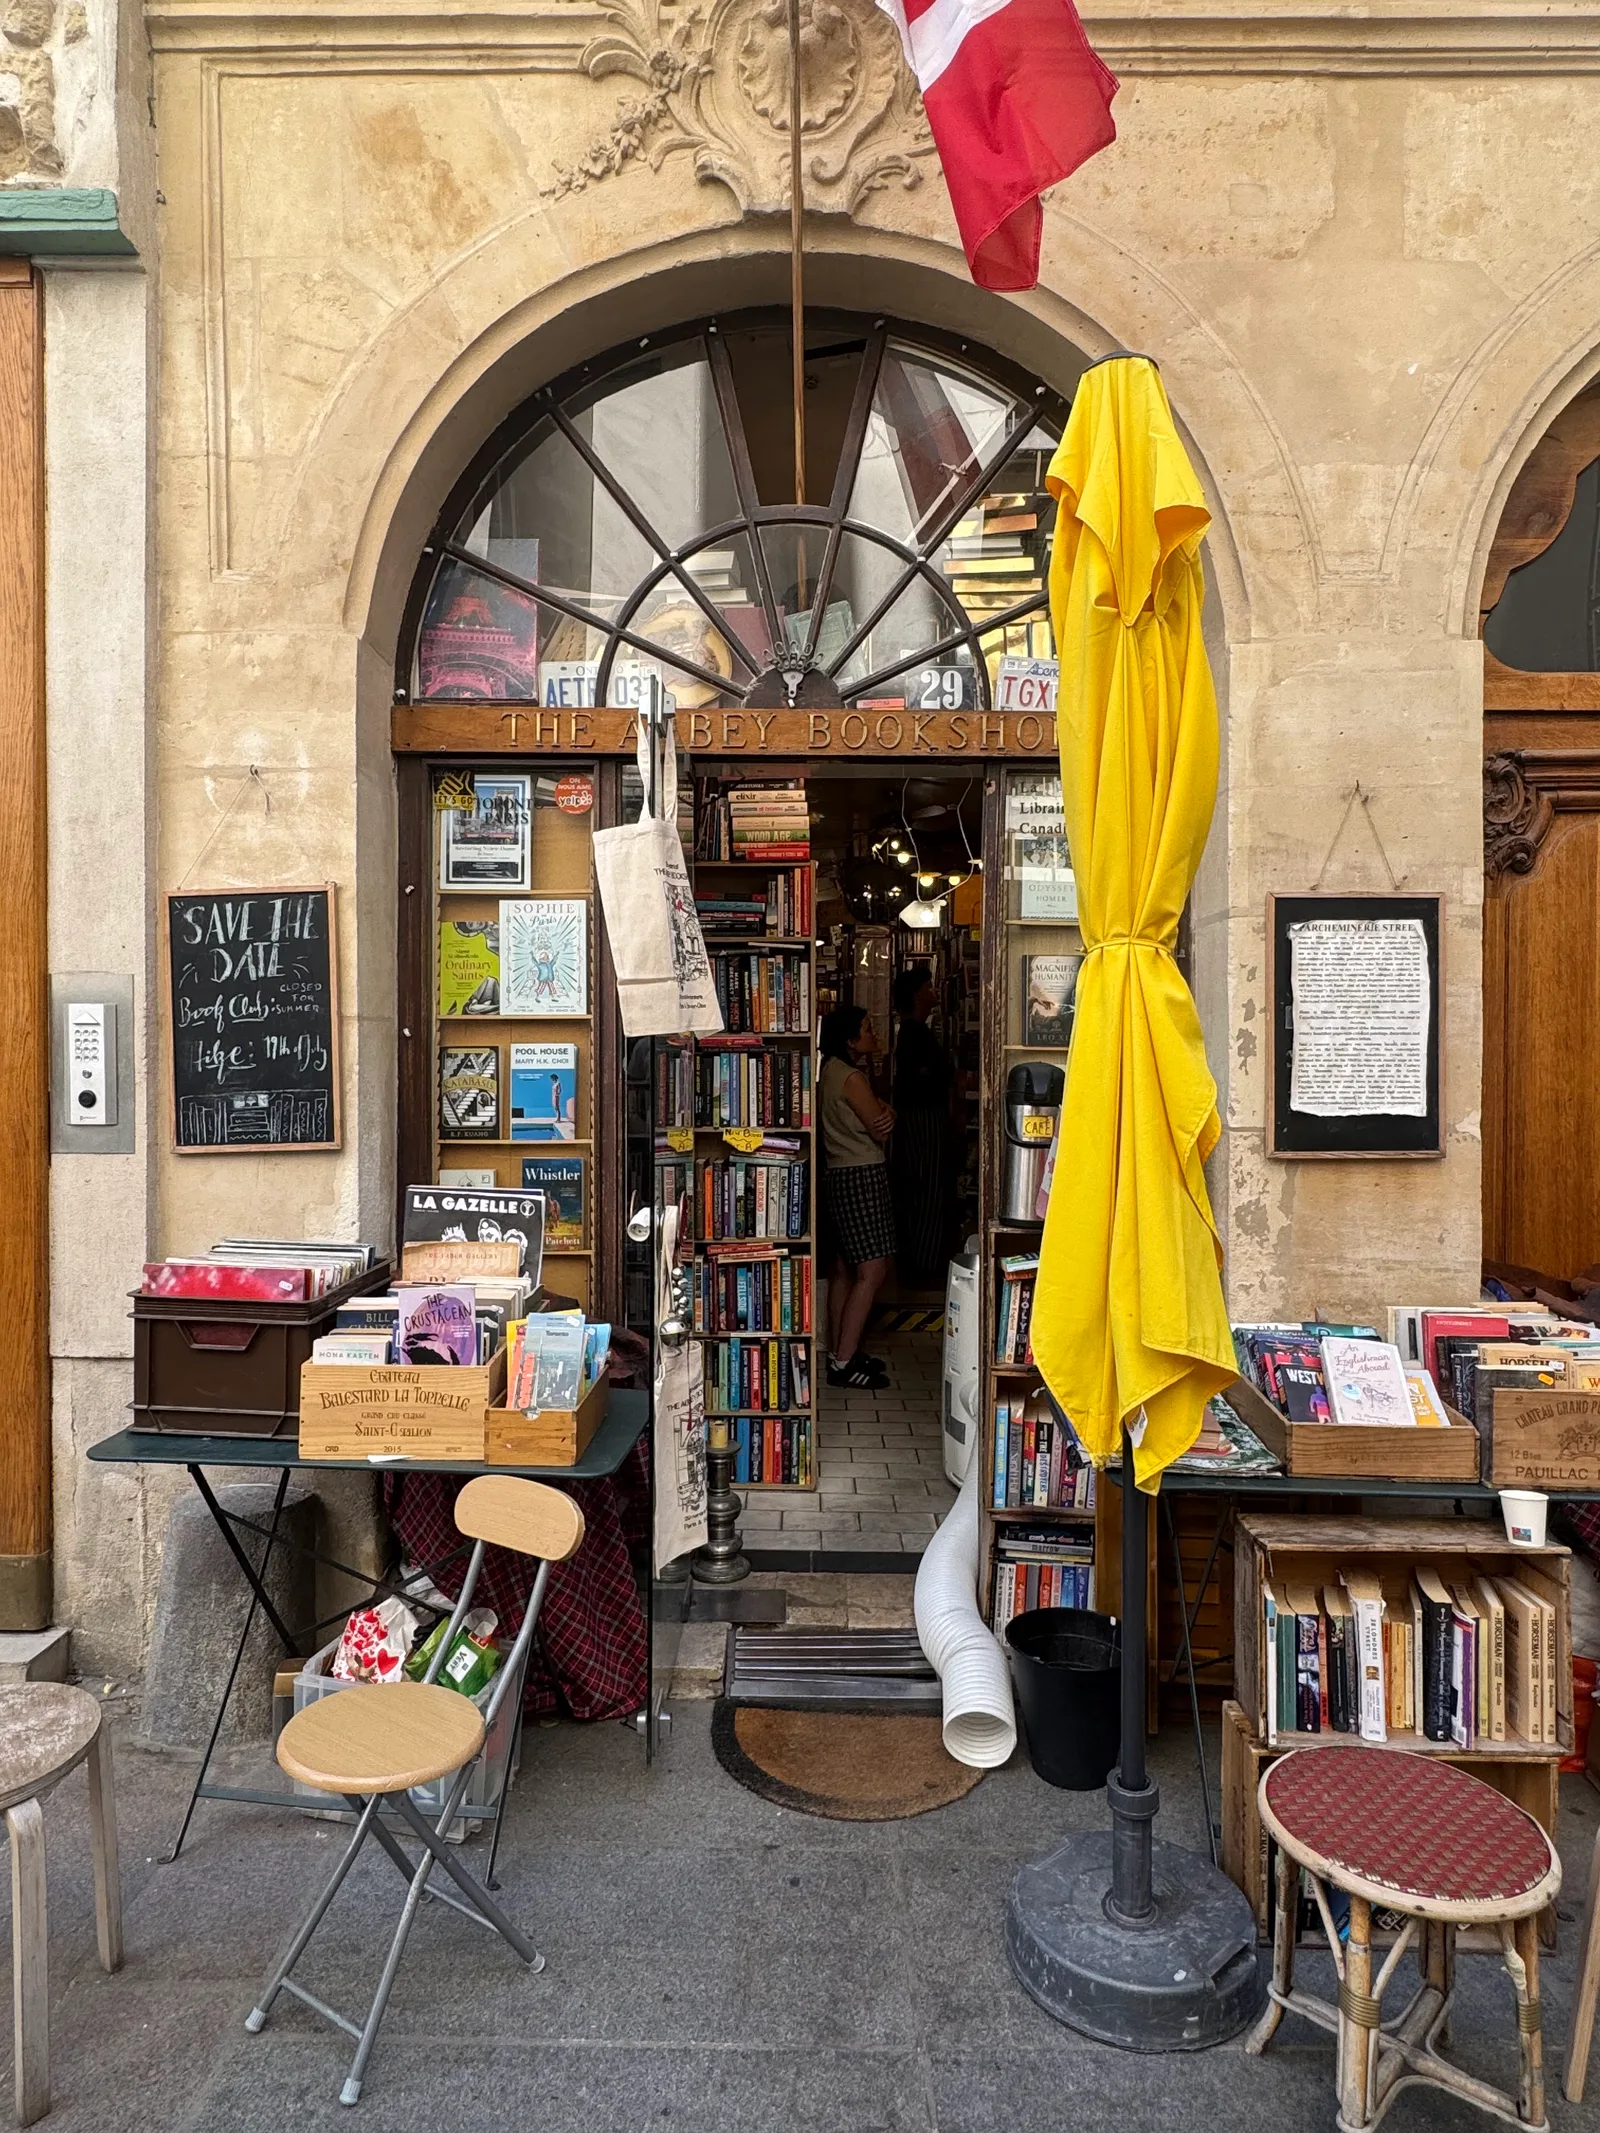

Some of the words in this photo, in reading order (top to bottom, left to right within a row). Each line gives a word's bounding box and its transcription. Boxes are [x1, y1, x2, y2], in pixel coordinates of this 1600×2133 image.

[921, 670, 963, 709] 29
[500, 712, 595, 748] THE
[618, 712, 775, 749] ABEY
[1019, 781, 1038, 794] La
[558, 795, 581, 808] yelp
[735, 792, 757, 801] elixir
[476, 797, 545, 811] TORONTO
[484, 812, 530, 825] PARIS
[746, 830, 771, 842] WOOD
[773, 830, 792, 842] AGE
[1028, 883, 1075, 893] ODYSSEY
[1036, 895, 1068, 903] HOMER
[514, 903, 575, 914] SOPHIE
[183, 900, 258, 945] SAVE
[268, 894, 323, 942] THE
[528, 915, 557, 928] Paris
[209, 941, 290, 984] DATE
[445, 959, 491, 973] Ordinary
[452, 971, 484, 981] Saints
[1034, 973, 1073, 982] HUMANIT
[279, 983, 323, 992] CLOSED
[292, 994, 315, 1002] FOR
[178, 994, 226, 1034] Book
[276, 1004, 320, 1015] SUMMER
[515, 1047, 538, 1056] POOL
[539, 1047, 569, 1056] HOUSE
[443, 1077, 495, 1090] KATABASIS
[792, 1071, 800, 1088] JANE
[792, 1088, 801, 1113] SMILEY
[1024, 1117, 1051, 1136] CAFÉ
[525, 1167, 581, 1181] Whistler
[756, 1169, 765, 1186] WILD
[779, 1176, 788, 1198] Deficit
[412, 1195, 438, 1210] LA
[441, 1196, 519, 1215] GAZELLE
[756, 1187, 765, 1213] GROUND
[545, 1236, 581, 1246] Patchett
[422, 1292, 445, 1308] THE
[737, 1281, 747, 1312] FELLSIDE
[365, 1312, 390, 1323] BILL
[403, 1302, 473, 1333] CRUSTACEAN
[395, 1388, 410, 1403] LA
[666, 1402, 681, 1412] THE
[1514, 1403, 1555, 1429] CHATEAU
[1556, 1399, 1589, 1416] GRAND
[383, 1445, 403, 1453] 2015
[1039, 1441, 1048, 1453] THE
[1510, 1449, 1520, 1460] 12
[1010, 1452, 1022, 1476] Sarah
[1039, 1454, 1048, 1493] DESTROYERS
[1515, 1465, 1589, 1481] PAUILLAC
[1010, 1477, 1021, 1493] Hall
[1494, 1617, 1503, 1658] HORSEMAN
[1531, 1618, 1540, 1660] HORSEMAN
[1547, 1618, 1555, 1660] HORSEMAN
